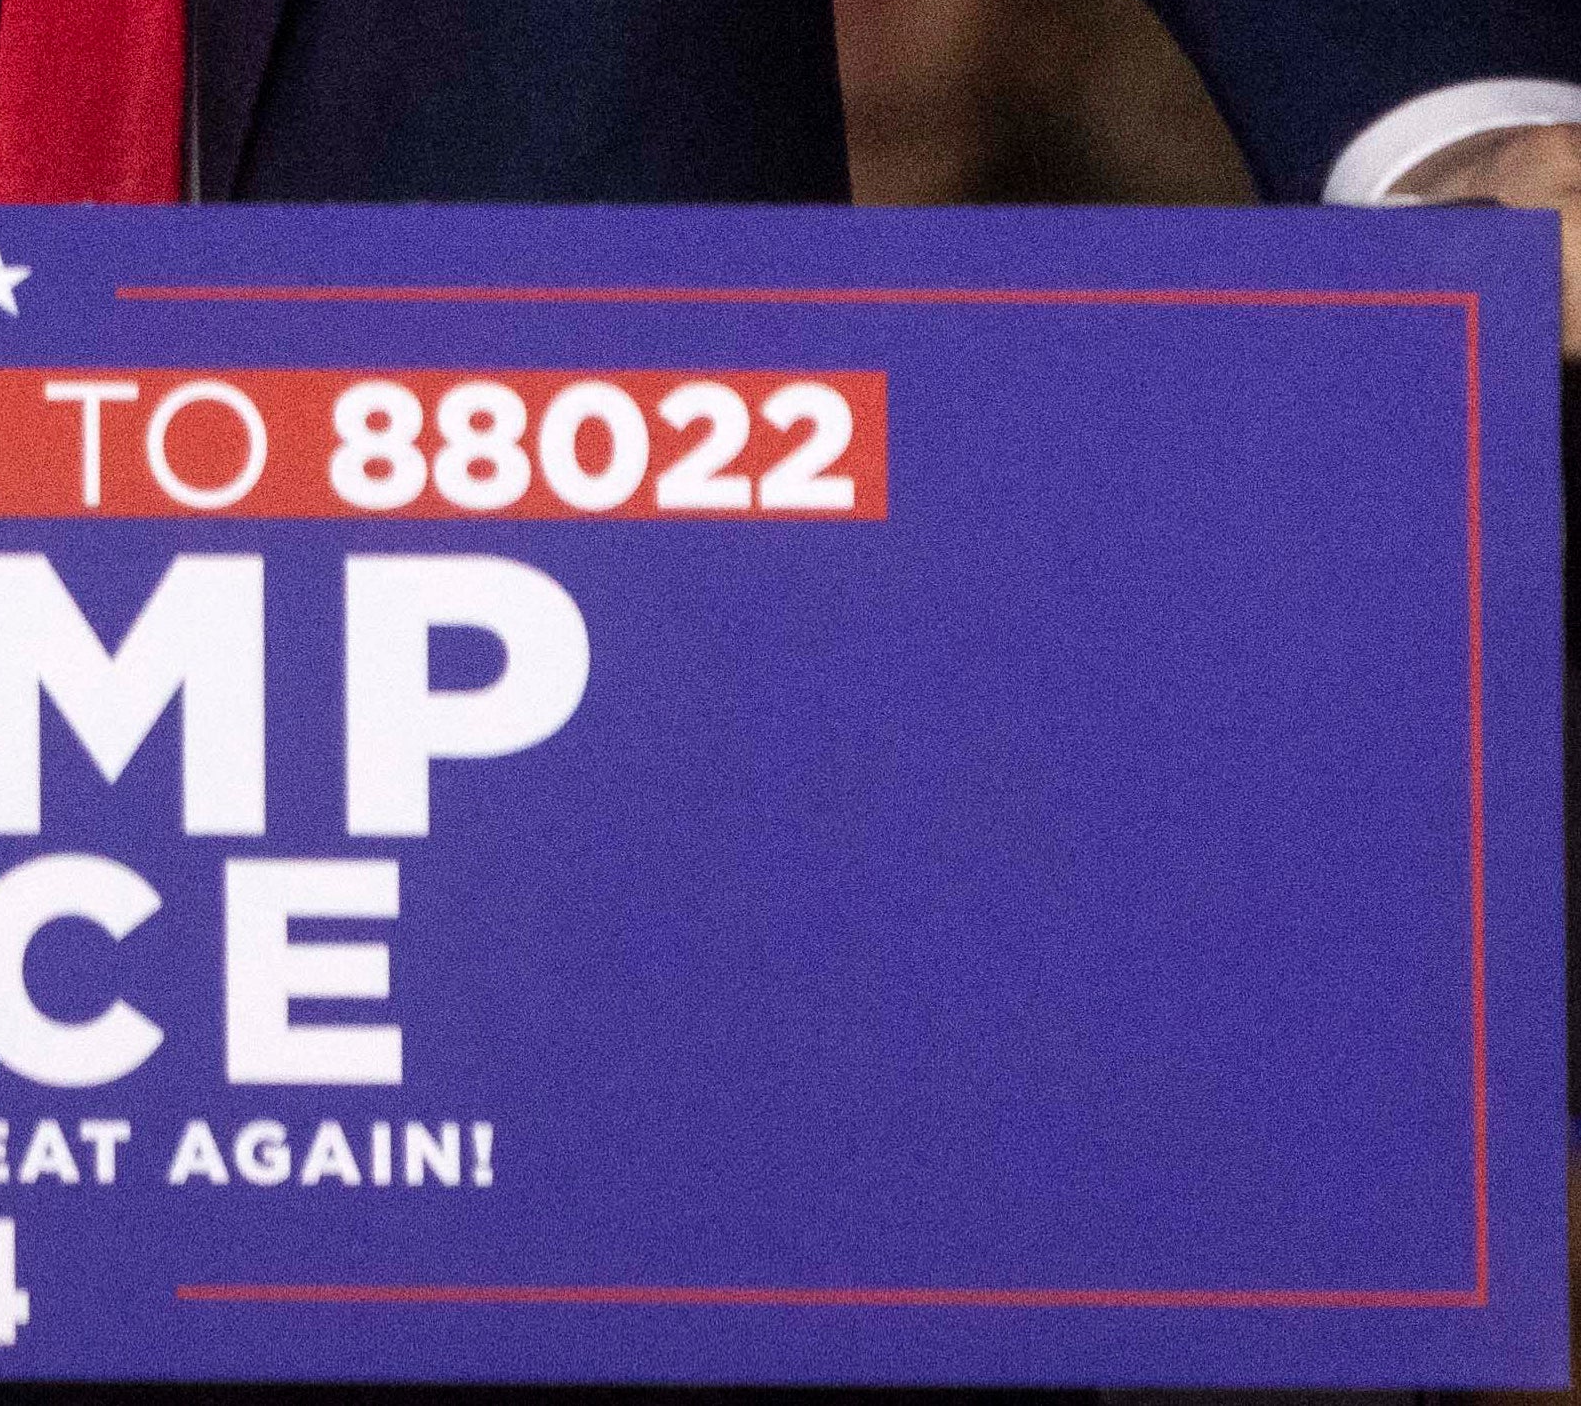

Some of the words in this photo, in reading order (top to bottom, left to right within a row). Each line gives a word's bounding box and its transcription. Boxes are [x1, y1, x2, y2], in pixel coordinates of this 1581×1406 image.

[42, 378, 269, 511] TO
[326, 378, 857, 514] 88022
[167, 1118, 495, 1188] AGAIN!
